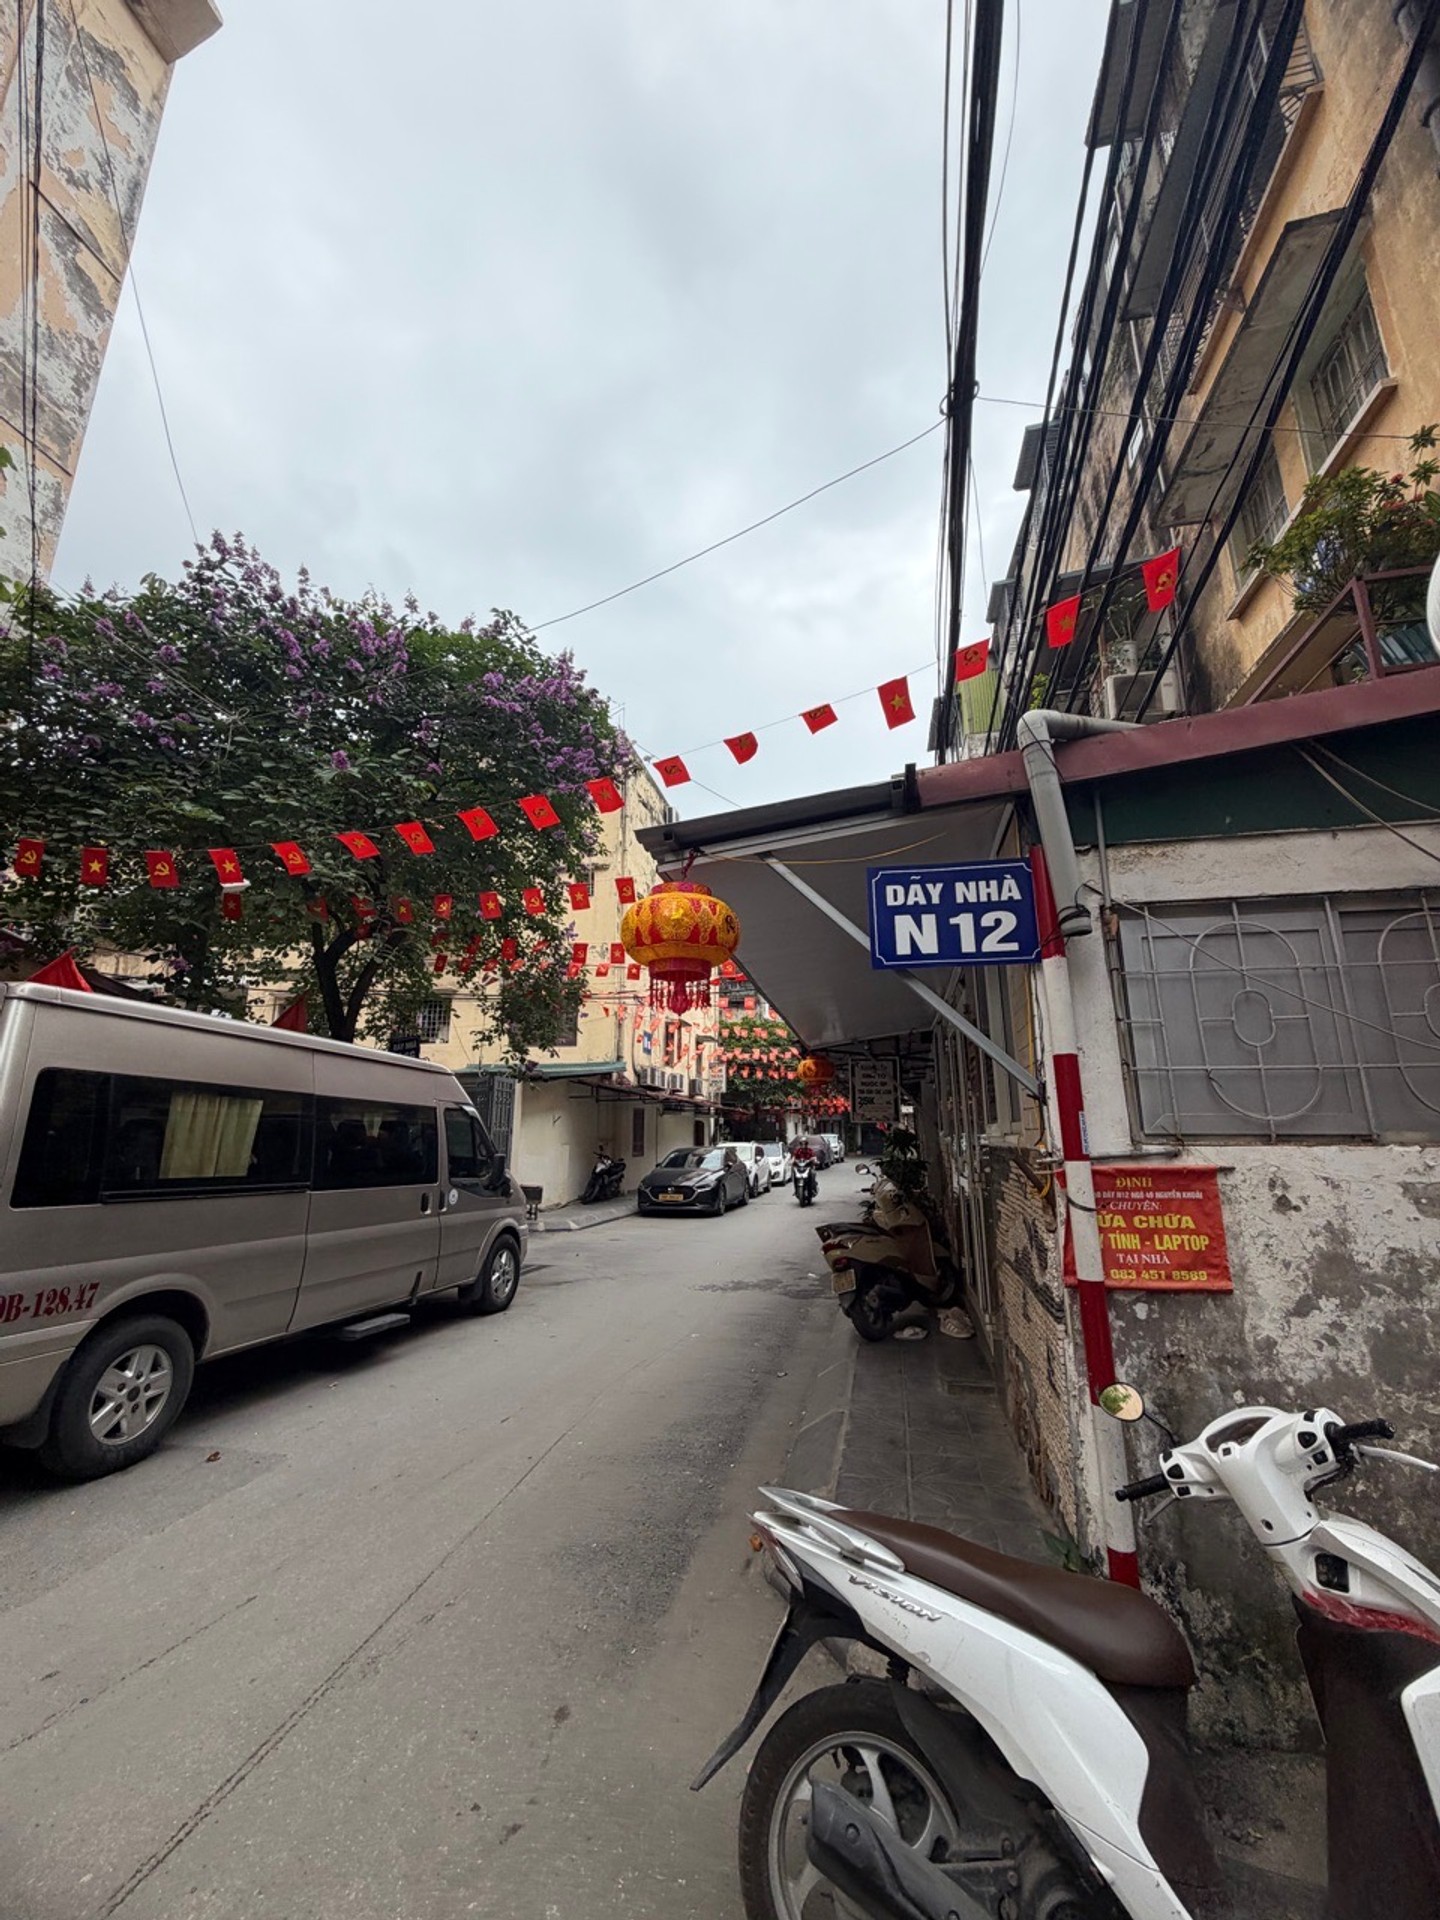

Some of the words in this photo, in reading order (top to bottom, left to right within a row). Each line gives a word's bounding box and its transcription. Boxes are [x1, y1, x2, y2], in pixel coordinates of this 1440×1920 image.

[886, 876, 943, 907] DÃY
[955, 874, 1022, 904] NHÀ
[894, 914, 939, 956] N
[949, 910, 1019, 954] 12
[1116, 1177, 1152, 1189] ĐỊNH
[1097, 1211, 1127, 1229] ỬA
[1133, 1213, 1196, 1229] CHỮA
[1109, 1230, 1141, 1250] TÍNH
[1155, 1234, 1210, 1251] LAPTOP
[1116, 1254, 1139, 1266] TẠI
[1142, 1252, 1171, 1265] NHÀ
[1110, 1269, 1137, 1280] 083
[1141, 1270, 1166, 1281] 451
[847, 1572, 943, 1622] VISION
